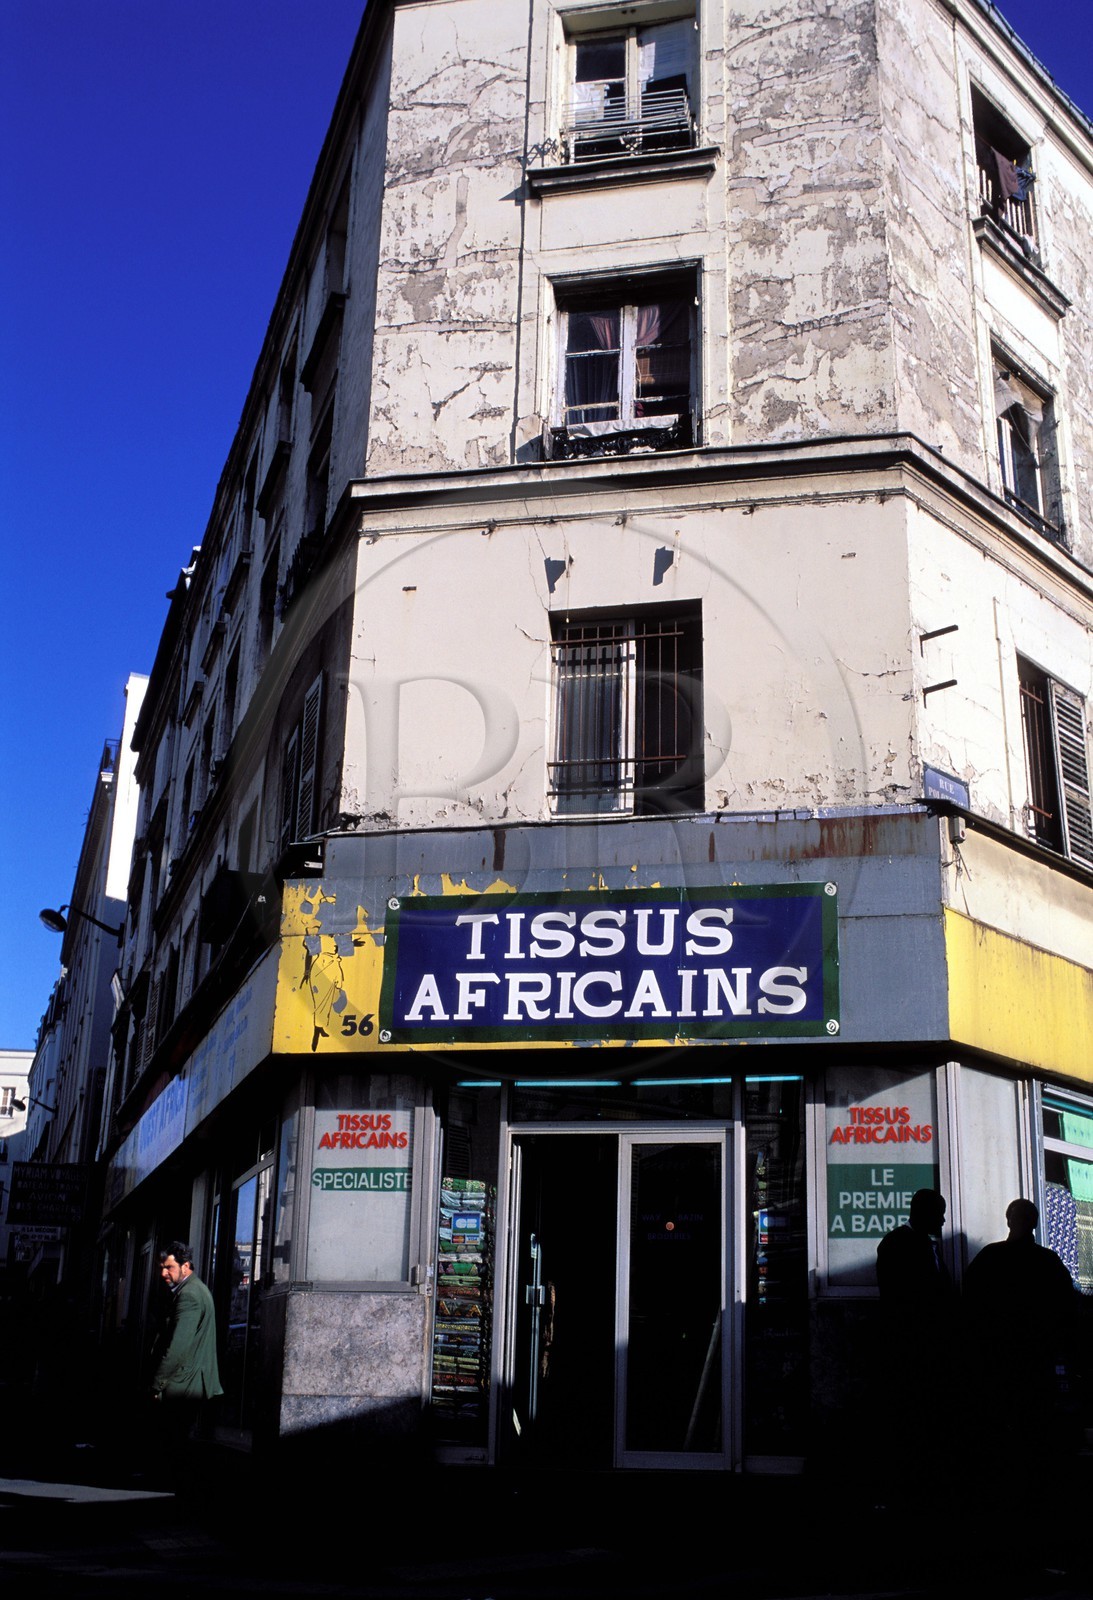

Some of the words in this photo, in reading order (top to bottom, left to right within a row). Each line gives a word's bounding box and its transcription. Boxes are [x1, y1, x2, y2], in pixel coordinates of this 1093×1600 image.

[939, 778, 955, 795] RUE
[456, 908, 733, 959] TISSUS
[404, 966, 807, 1021] AFRICAINS
[341, 1014, 375, 1036] 56
[337, 1114, 392, 1131] TISSUS
[848, 1107, 911, 1125] TISSUS
[318, 1132, 408, 1149] AFRICAINS
[829, 1125, 933, 1144] AFRICAINS
[871, 1168, 895, 1186] LE
[839, 1191, 916, 1209] PREMIE
[831, 1215, 846, 1232] A
